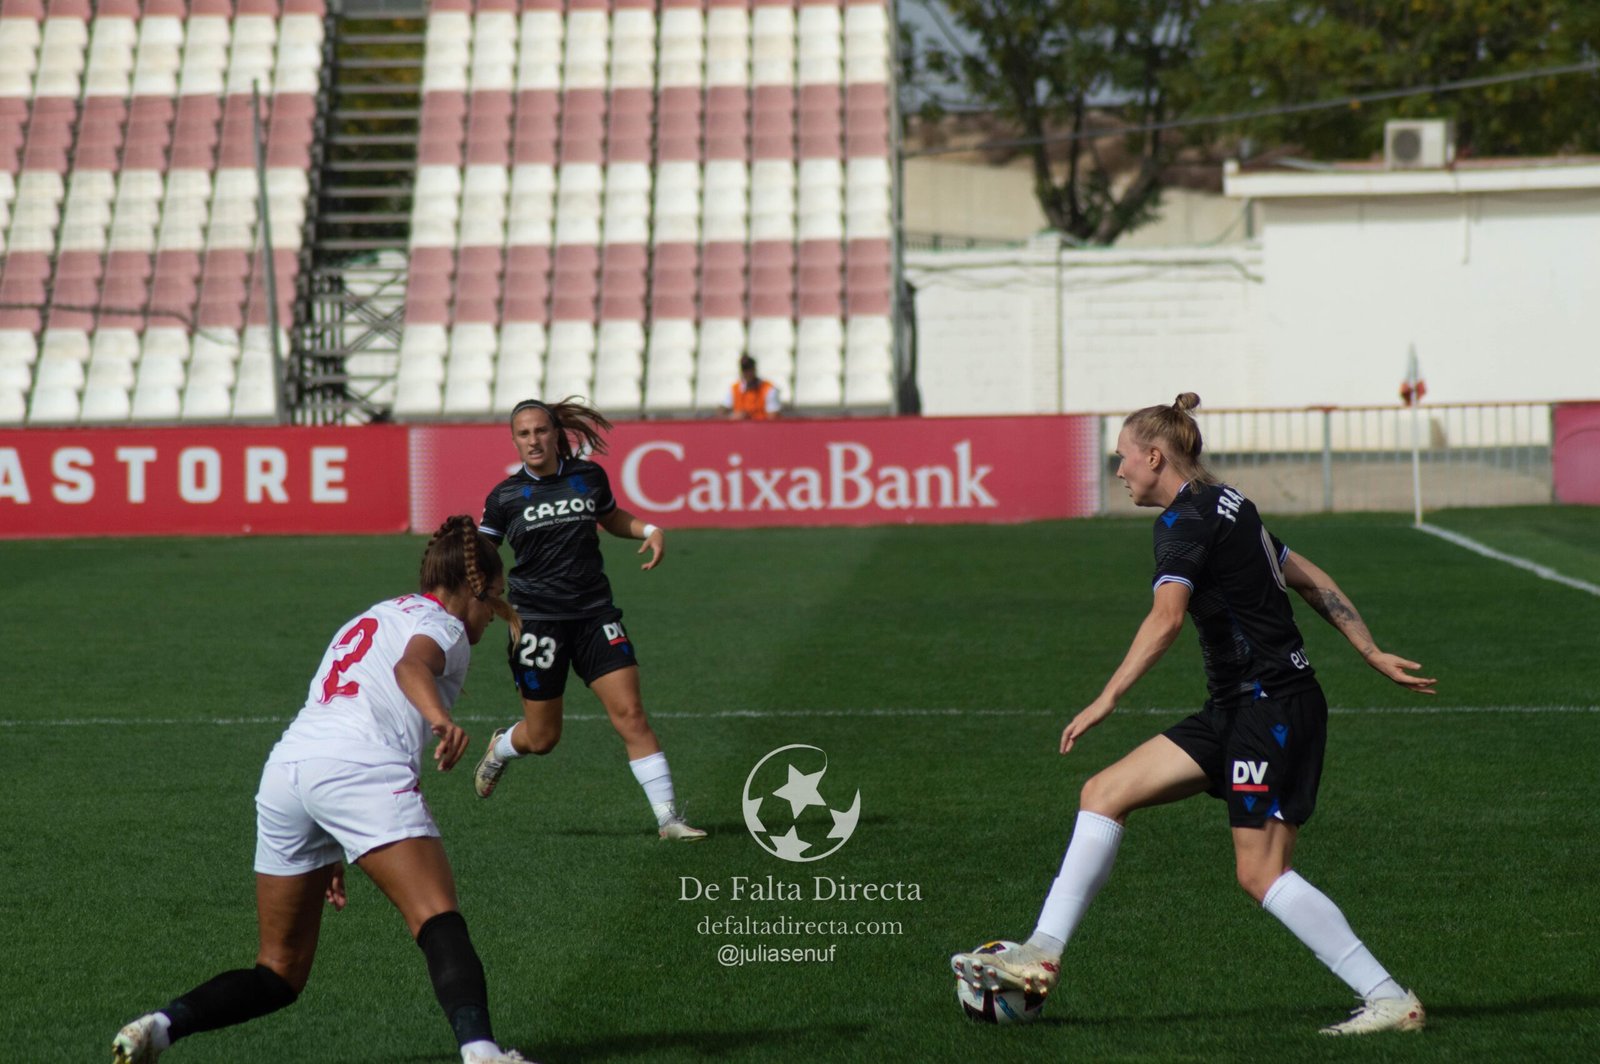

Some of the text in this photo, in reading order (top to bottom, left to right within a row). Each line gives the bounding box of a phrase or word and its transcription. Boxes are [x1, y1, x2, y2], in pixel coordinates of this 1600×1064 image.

[0, 446, 349, 505] ASTORE
[621, 440, 998, 513] CaixaBank
[523, 498, 596, 522] CAZOO
[1217, 487, 1246, 523] FRA
[317, 618, 379, 705] 2
[520, 633, 556, 669] 23
[1232, 760, 1269, 785] DV
